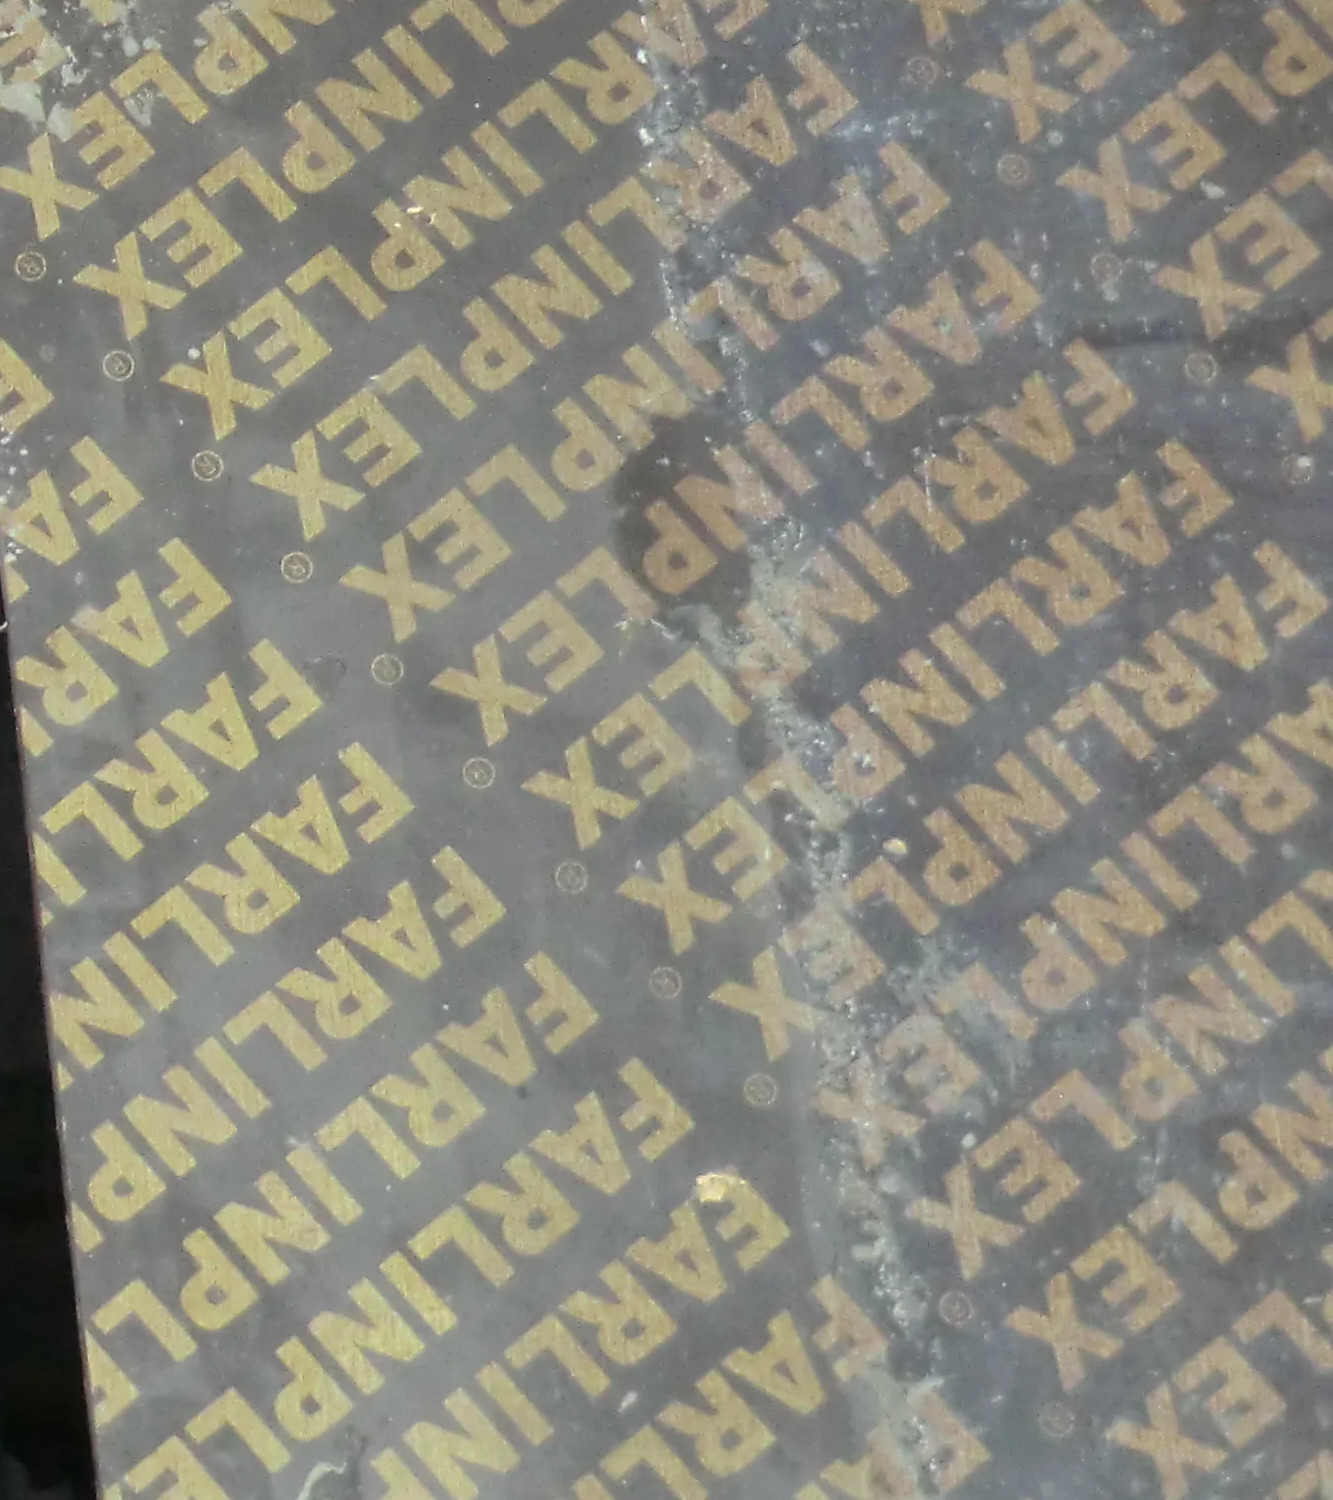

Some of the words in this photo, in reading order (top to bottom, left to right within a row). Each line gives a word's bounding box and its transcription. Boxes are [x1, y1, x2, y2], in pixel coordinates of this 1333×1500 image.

[249, 39, 863, 543] FARLINPLEX
[339, 137, 955, 645] FARLINPLEX
[430, 235, 1048, 749] FARLINPLEX
[27, 636, 325, 933] FARLI
[522, 335, 1141, 853] FARLINPLEX
[615, 435, 1236, 958] FARLINPLEX
[709, 537, 1332, 1065] FARLINPLEX
[44, 739, 417, 1098] FARLIN
[900, 850, 1333, 1281] LINPLEX
[96, 1055, 697, 1500] FARLINPLE
[997, 1039, 1333, 1391] NPLEX
[1095, 1231, 1333, 1500] LEX
